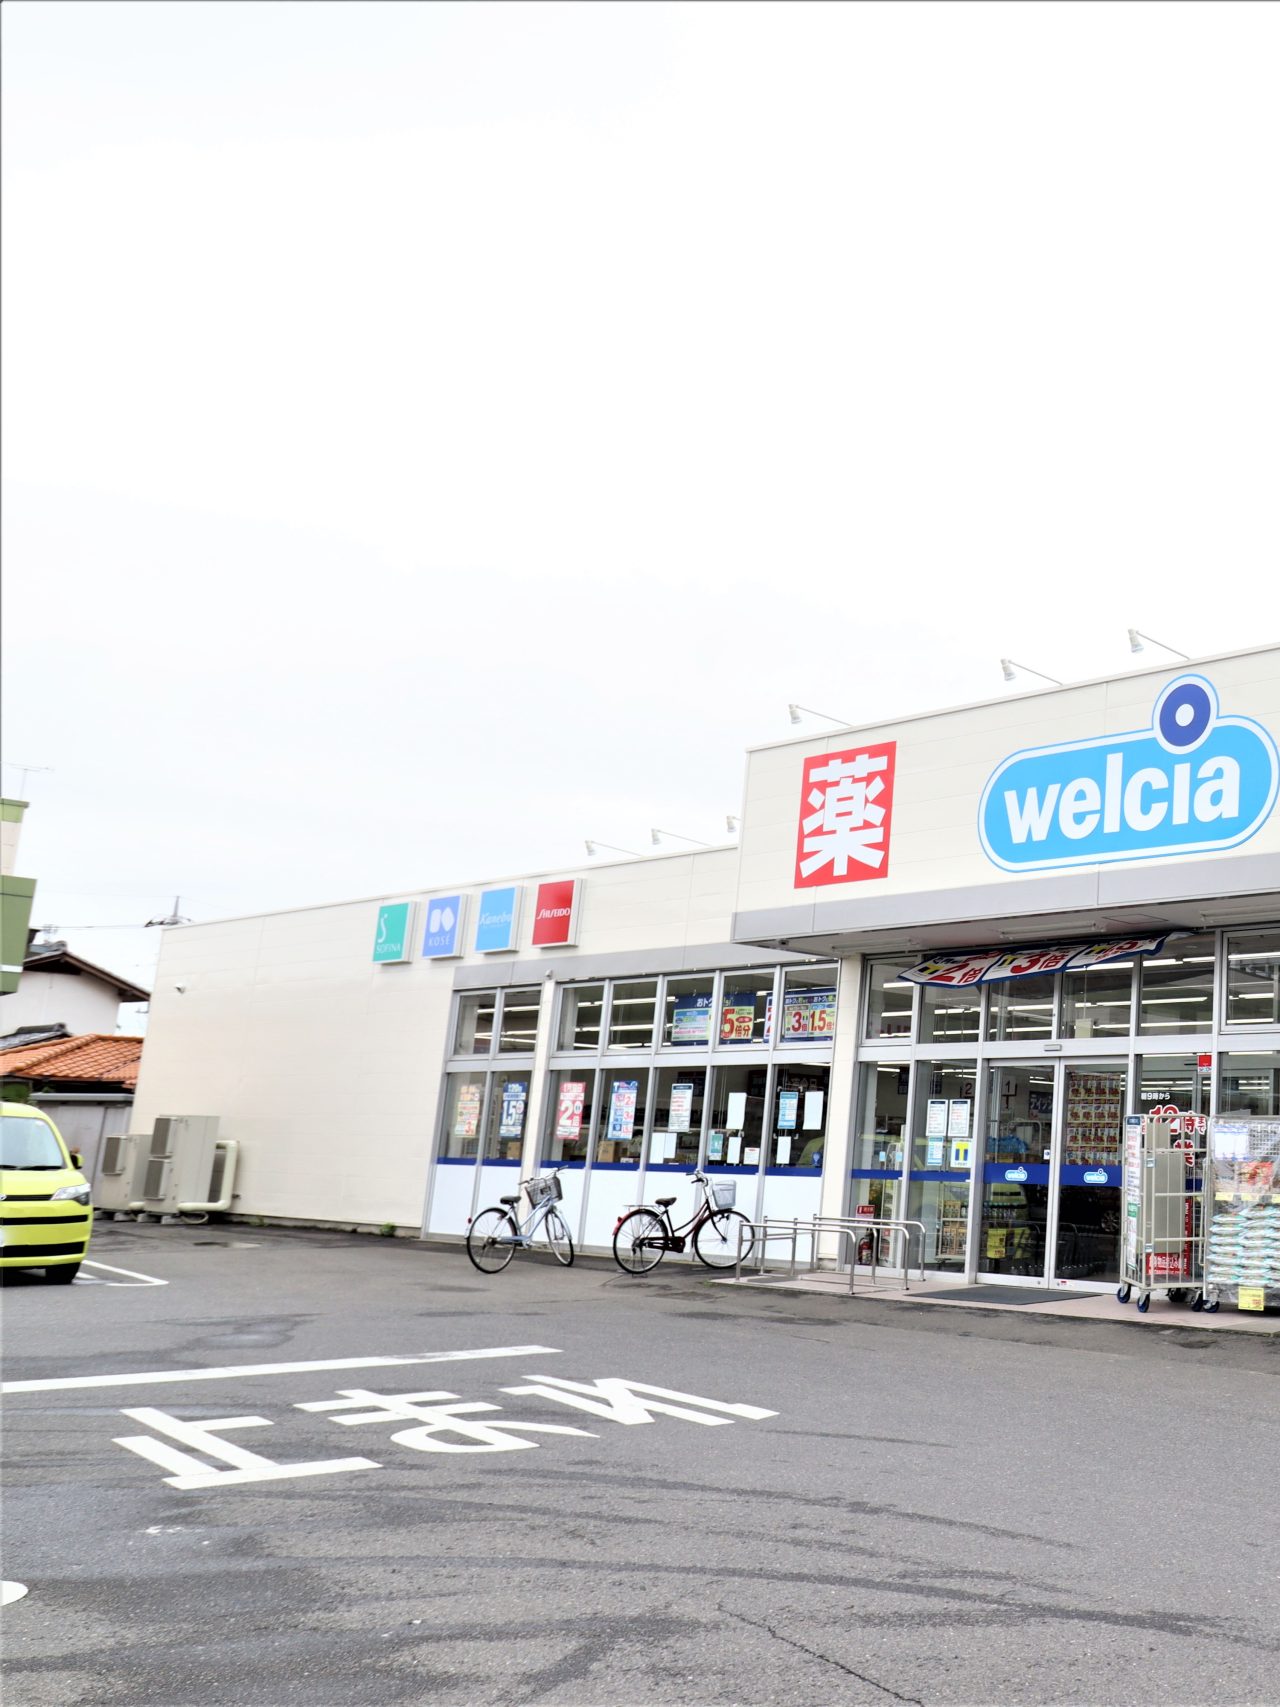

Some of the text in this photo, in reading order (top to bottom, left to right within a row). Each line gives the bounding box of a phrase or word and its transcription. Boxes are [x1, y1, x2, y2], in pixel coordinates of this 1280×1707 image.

[1003, 683, 1241, 844] welcia
[799, 753, 889, 878] 薬
[480, 911, 512, 924] Kanebo
[537, 908, 571, 920] SHISEIDO
[376, 943, 402, 953] SOFINA
[111, 1375, 781, 1490] 止まれ
